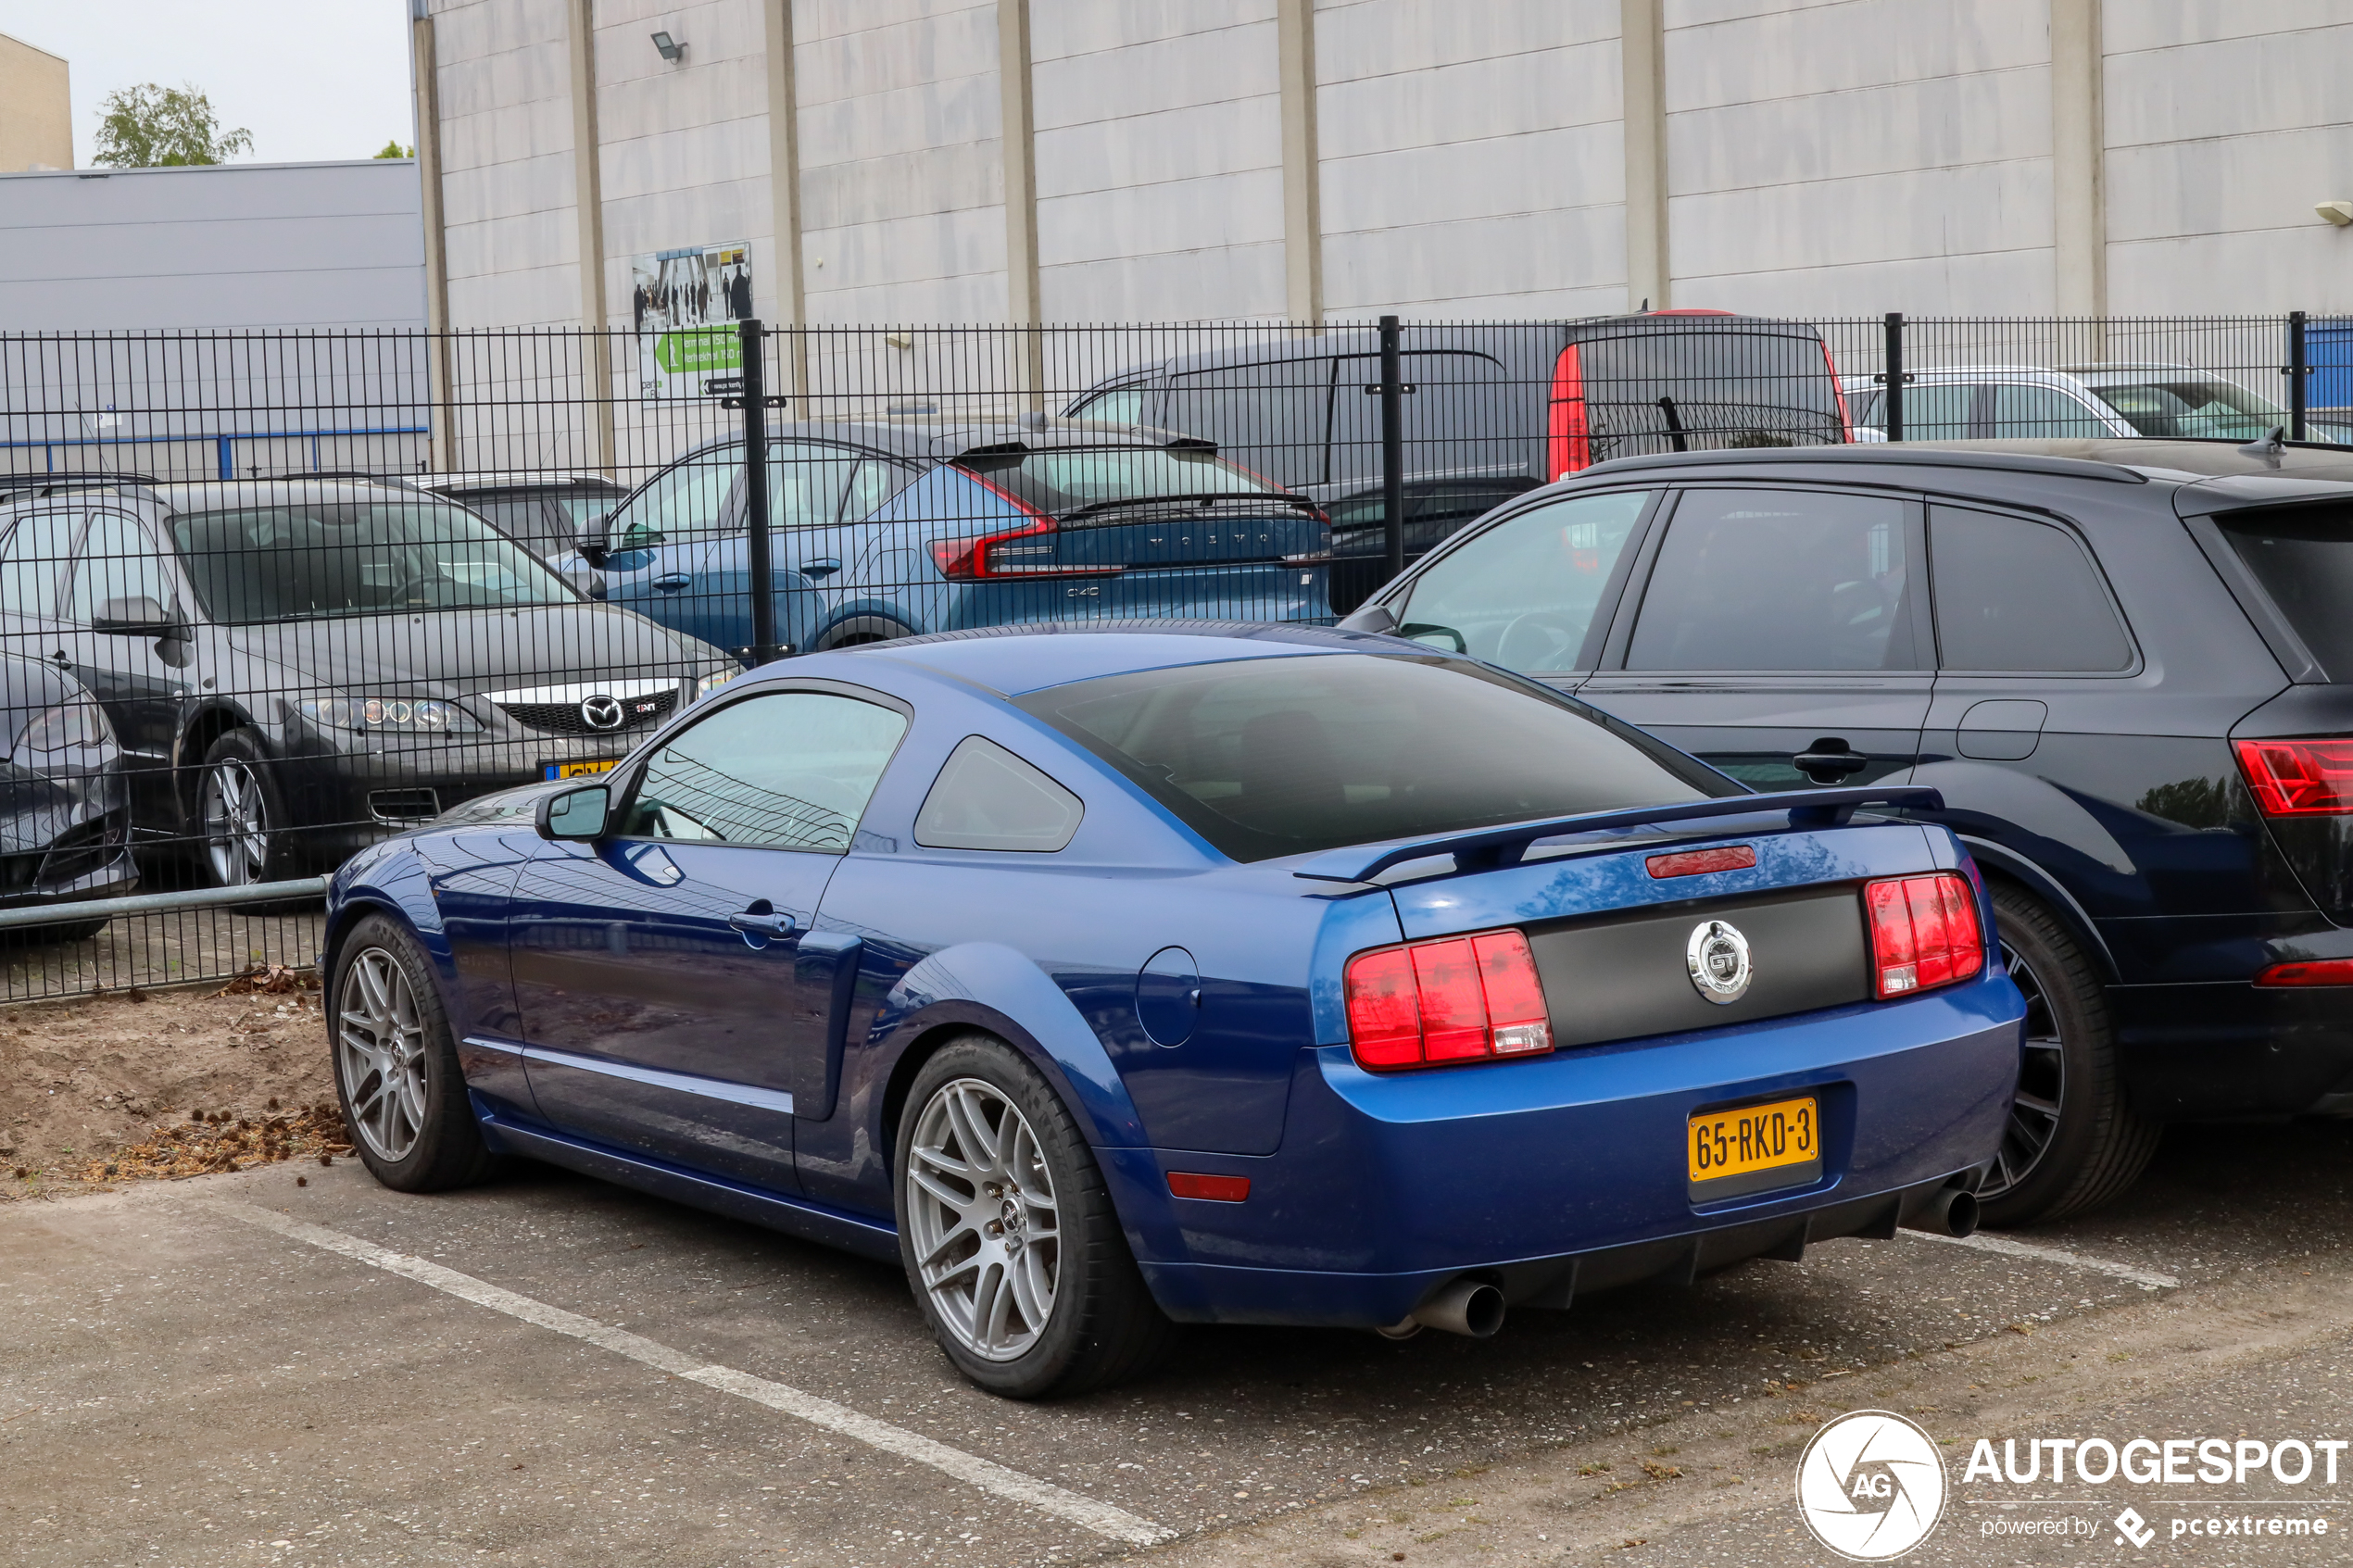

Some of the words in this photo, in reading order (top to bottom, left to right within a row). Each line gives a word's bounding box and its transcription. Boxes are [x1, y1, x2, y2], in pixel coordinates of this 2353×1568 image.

[680, 335, 711, 348] ermnal
[1709, 952, 1736, 970] GT
[1696, 1108, 1810, 1170] 65-RKD-3
